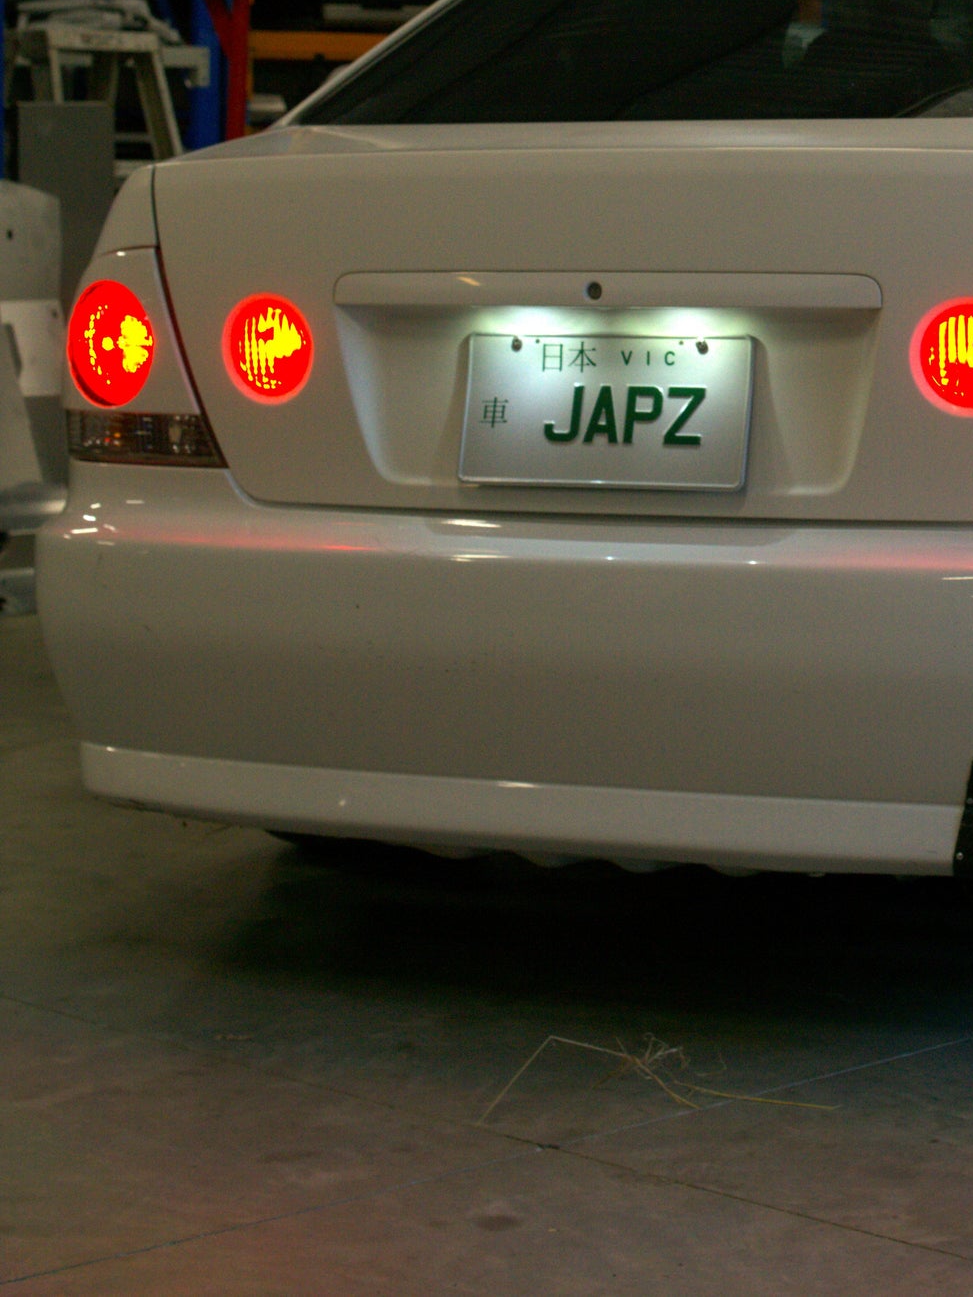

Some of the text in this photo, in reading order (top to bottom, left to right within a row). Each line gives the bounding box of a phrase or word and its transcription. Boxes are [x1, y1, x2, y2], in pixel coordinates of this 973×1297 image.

[542, 341, 597, 373] 日本
[621, 351, 676, 366] VIC
[479, 397, 509, 429] 車
[543, 382, 707, 446] JAPZ
